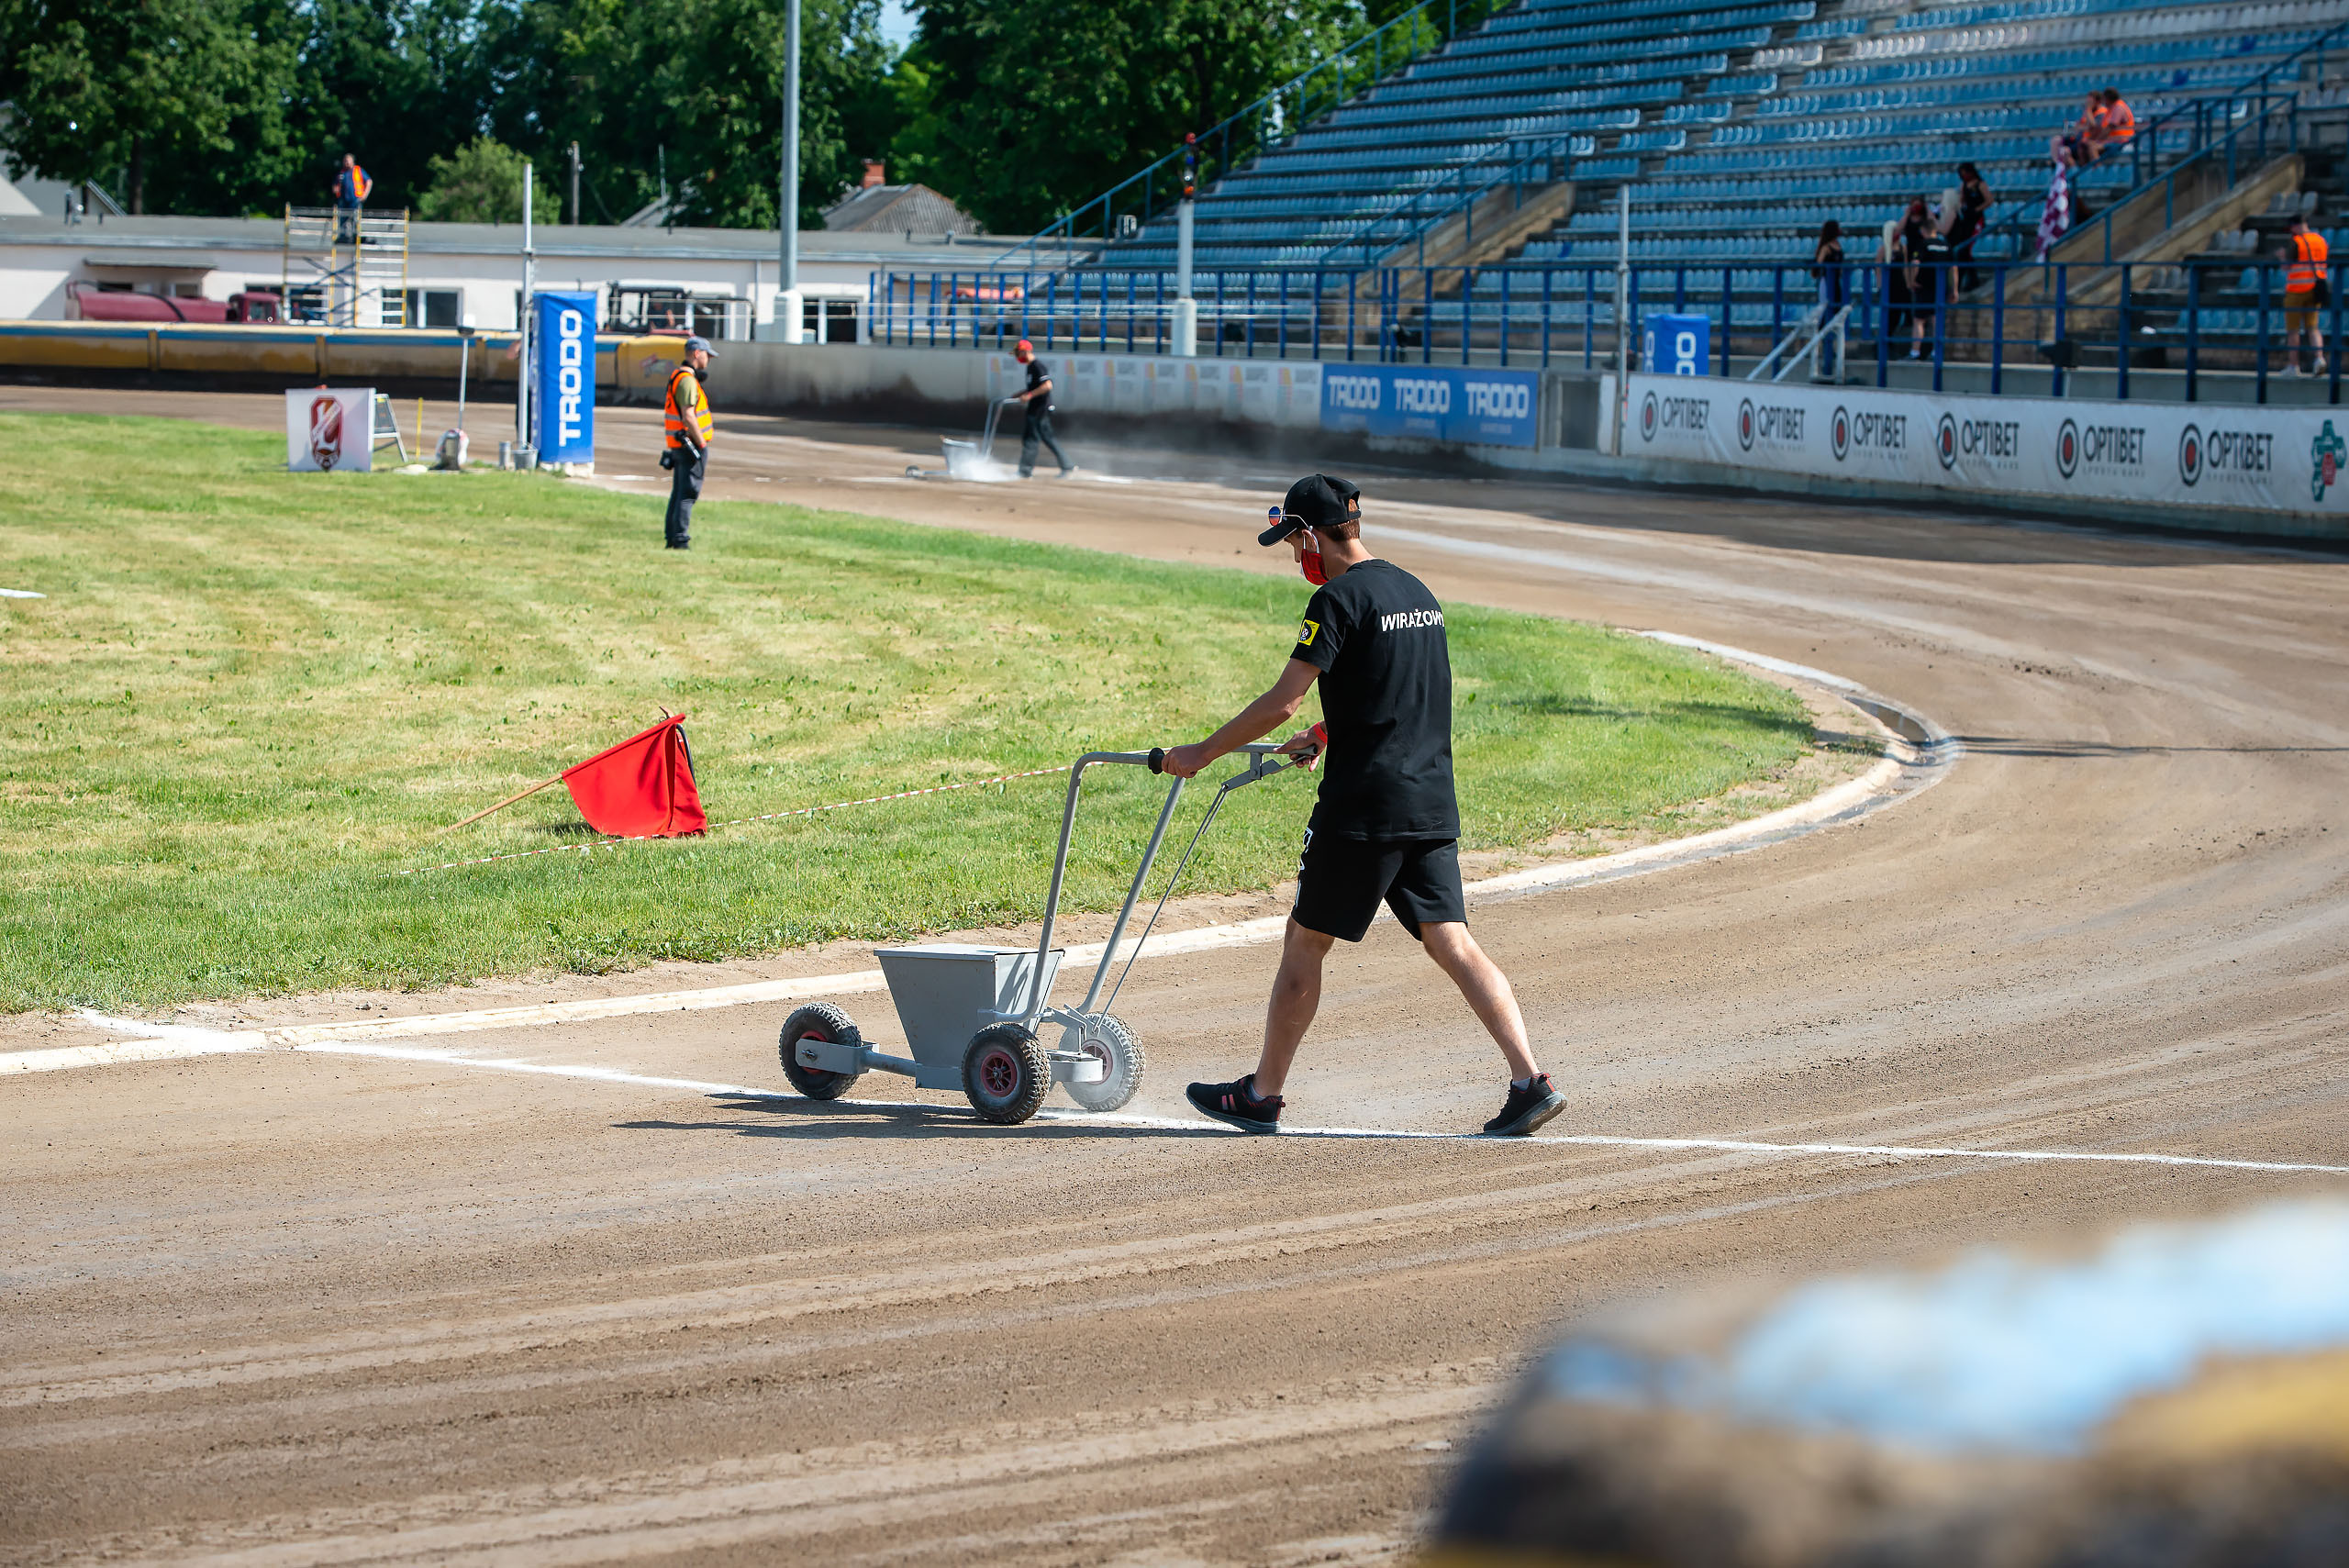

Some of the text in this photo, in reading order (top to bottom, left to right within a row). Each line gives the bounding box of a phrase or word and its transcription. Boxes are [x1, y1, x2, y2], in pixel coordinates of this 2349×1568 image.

[559, 309, 583, 447] TRODO
[1327, 375, 1381, 409] TRODO
[1394, 378, 1451, 414] TRODO
[1464, 382, 1531, 418] TRODO
[1757, 405, 1806, 440] OPTIBET
[1854, 411, 1908, 449] OPTIBET
[1962, 419, 2020, 458] OPTIBET
[2083, 425, 2146, 465] OPTIBET
[2207, 429, 2274, 472] OPTIBET
